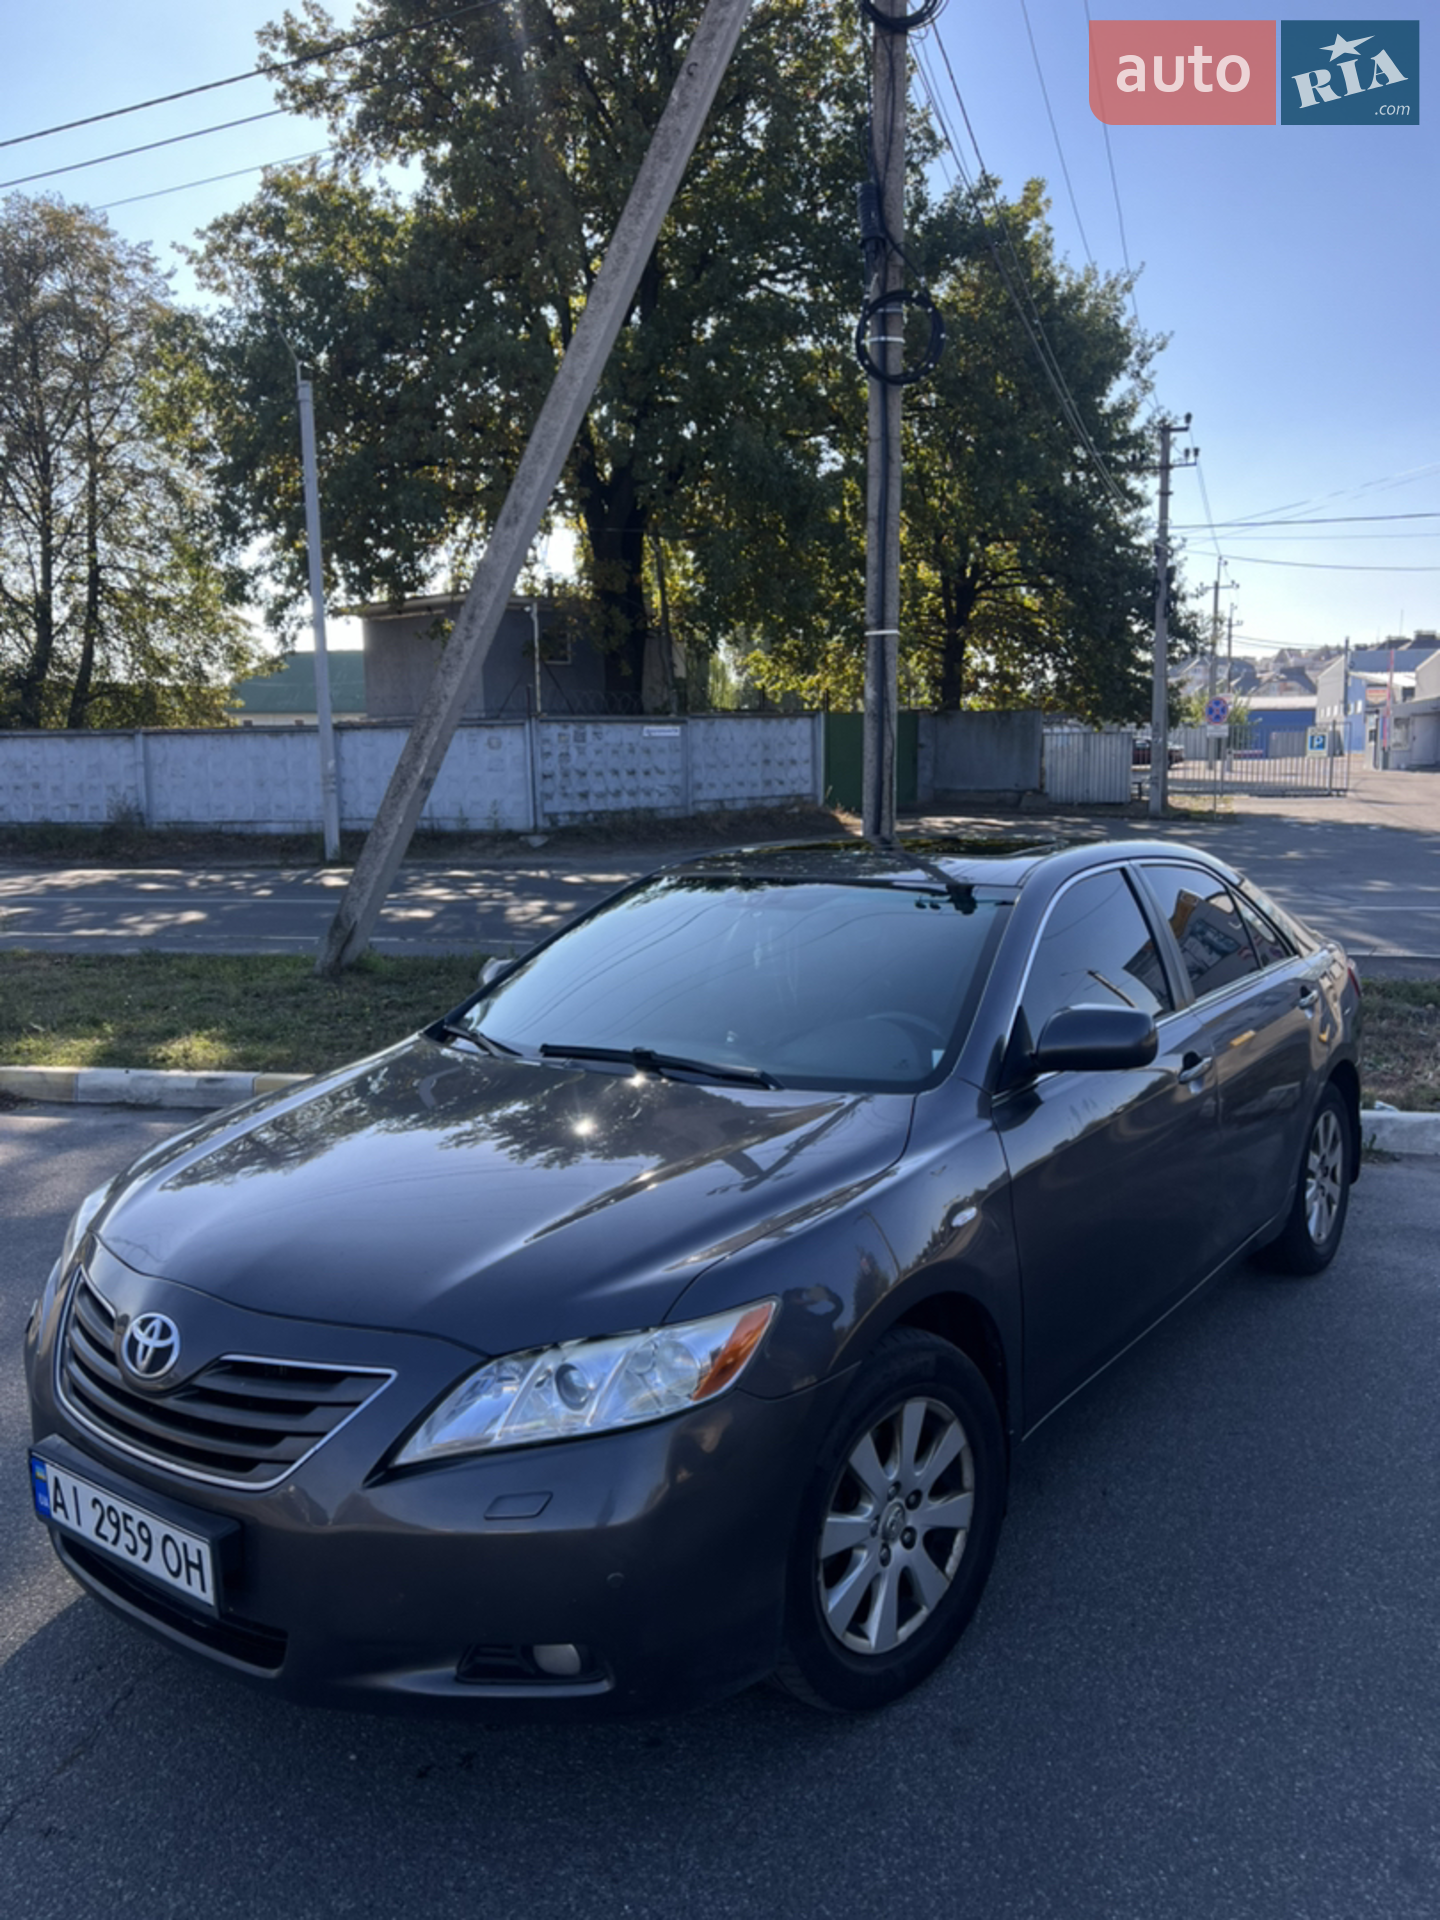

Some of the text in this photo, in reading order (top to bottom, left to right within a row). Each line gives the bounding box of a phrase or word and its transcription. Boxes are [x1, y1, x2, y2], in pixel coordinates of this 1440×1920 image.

[53, 1476, 207, 1594] AI 2959 OH
